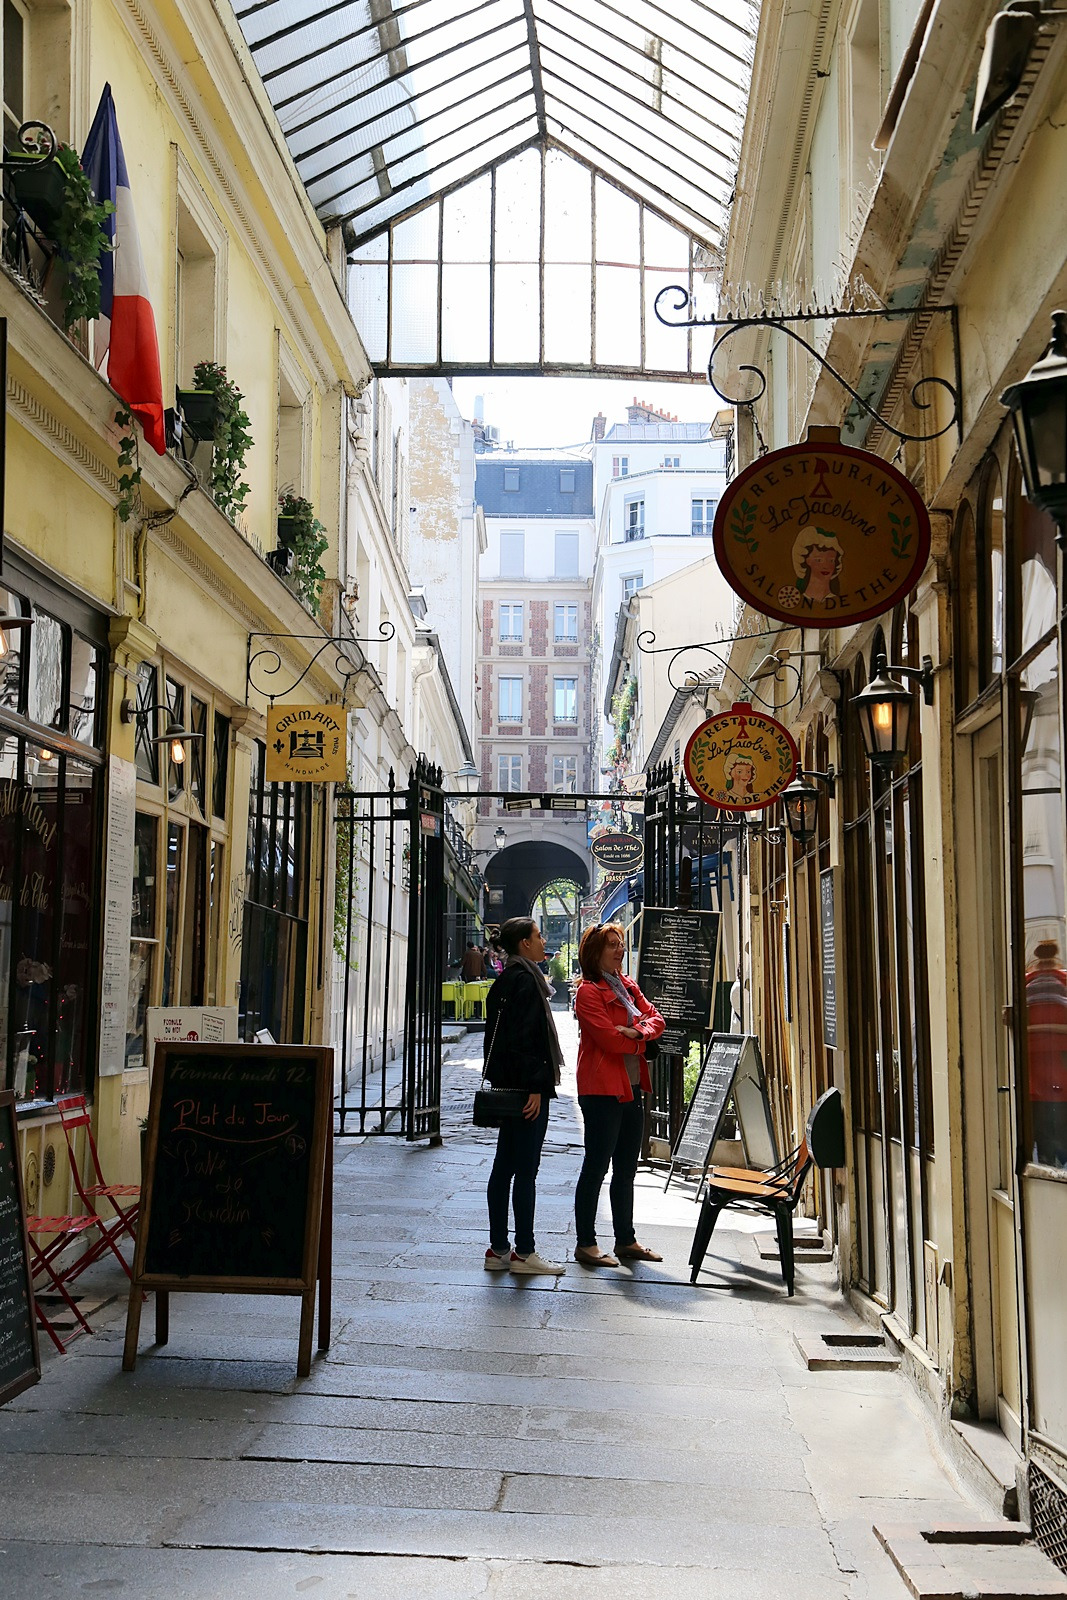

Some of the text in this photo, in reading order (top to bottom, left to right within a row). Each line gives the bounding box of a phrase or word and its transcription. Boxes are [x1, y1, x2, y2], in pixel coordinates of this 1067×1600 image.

[760, 495, 878, 537] La Jacobine
[824, 595, 850, 610] DE
[276, 710, 340, 732] GRIMART
[707, 737, 772, 761] La Jacobine
[284, 762, 330, 775] HANDMADE
[743, 793, 760, 804] DE
[594, 844, 612, 852] Salon
[170, 1059, 233, 1081] Formule
[173, 1099, 290, 1127] Plat du Jour
